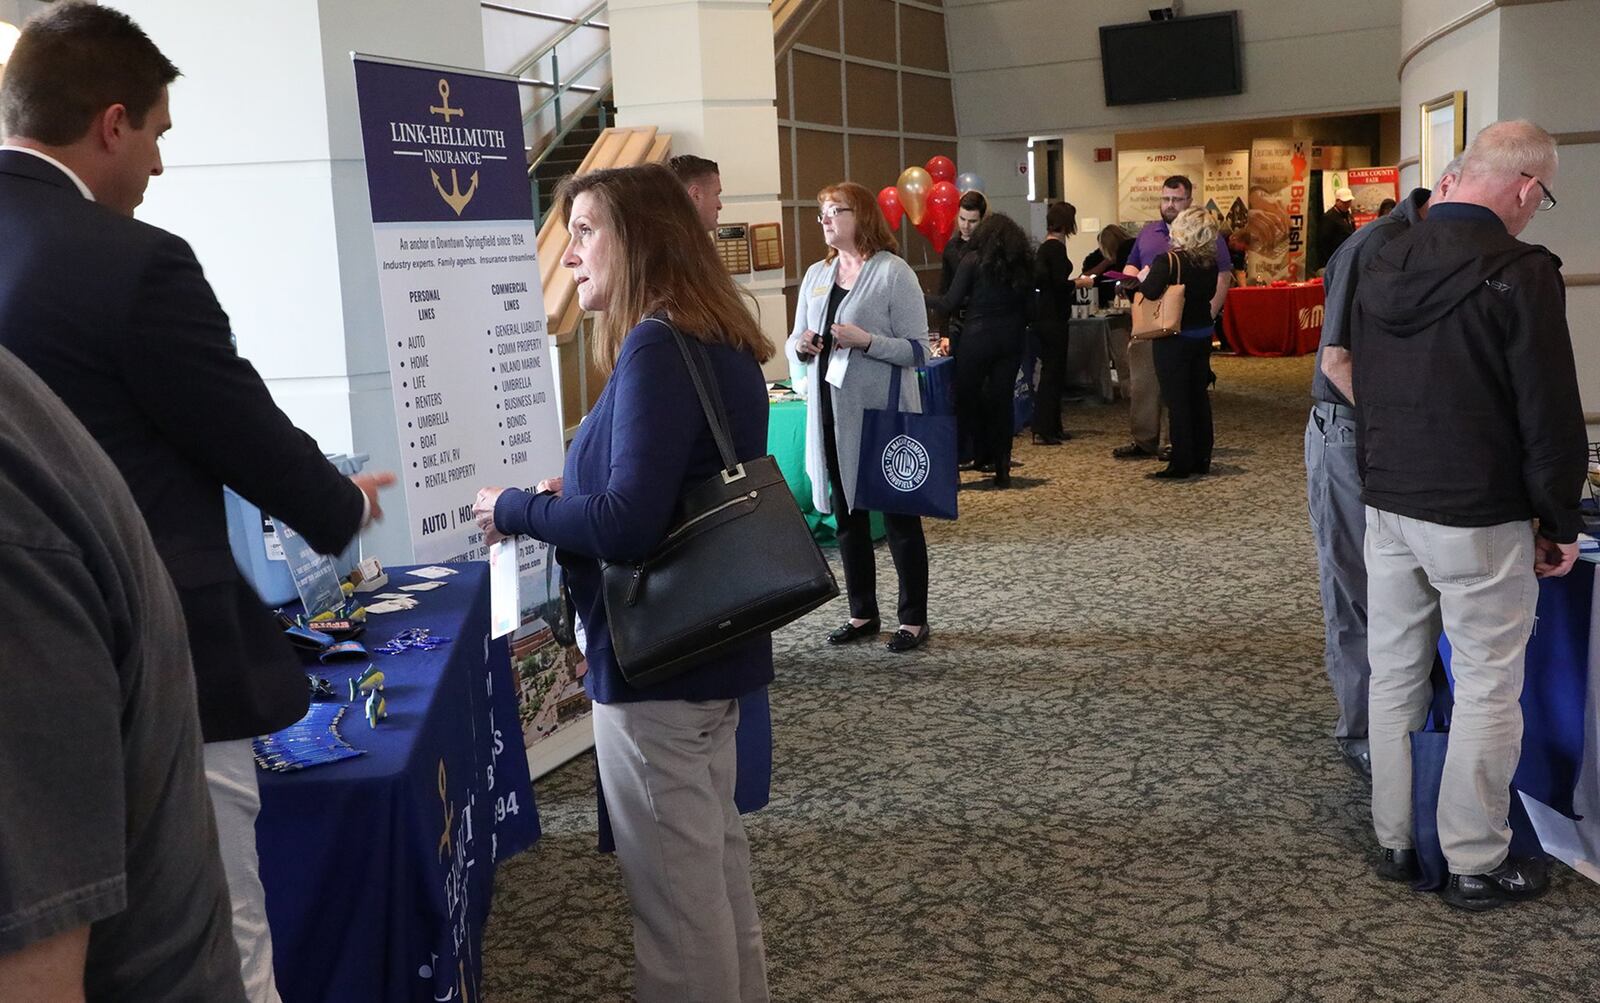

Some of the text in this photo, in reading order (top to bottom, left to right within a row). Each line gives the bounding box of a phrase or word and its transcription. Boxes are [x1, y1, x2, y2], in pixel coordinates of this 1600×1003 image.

[390, 122, 506, 149] LINK-HELLMUTH
[423, 150, 482, 165] INSURANCE
[1369, 169, 1395, 177] COUNTY
[400, 237, 409, 250] An
[409, 237, 429, 250] anchor
[430, 238, 437, 250] in
[436, 236, 464, 249] Downtown
[465, 233, 496, 250] Springfield
[497, 235, 511, 247] since
[383, 259, 411, 271] Industry
[437, 257, 455, 268] Family
[480, 255, 507, 264] Insurance
[409, 289, 441, 303] PERSONAL
[491, 282, 528, 296] COMMERCIAL
[503, 299, 520, 311] LINES
[418, 308, 436, 321] LINES
[495, 319, 543, 337] GENERAL LIABILITY
[408, 335, 426, 349] AUTO
[497, 338, 542, 356] COMM PROPERTY
[410, 354, 430, 369] HOME
[500, 356, 542, 374] INLAND MARINE
[412, 375, 427, 390] LIFE
[501, 377, 532, 393] UMBRELLA
[415, 392, 443, 409] RENTERS
[504, 391, 546, 411] BUSINESS AUTO
[417, 411, 449, 429] UMBRELLA
[506, 413, 527, 429] BONDS
[420, 433, 437, 449] BOAT
[508, 431, 532, 447] GARAGE
[422, 452, 440, 469] BIKE,
[452, 448, 461, 462] RV
[511, 451, 528, 466] FARM
[885, 448, 895, 461] THE
[907, 440, 927, 466] COMPANY
[424, 463, 476, 489] RENTAL PROPERTY
[913, 469, 926, 484] OHIO
[422, 513, 448, 536] AUTO
[519, 558, 542, 572] ance.com
